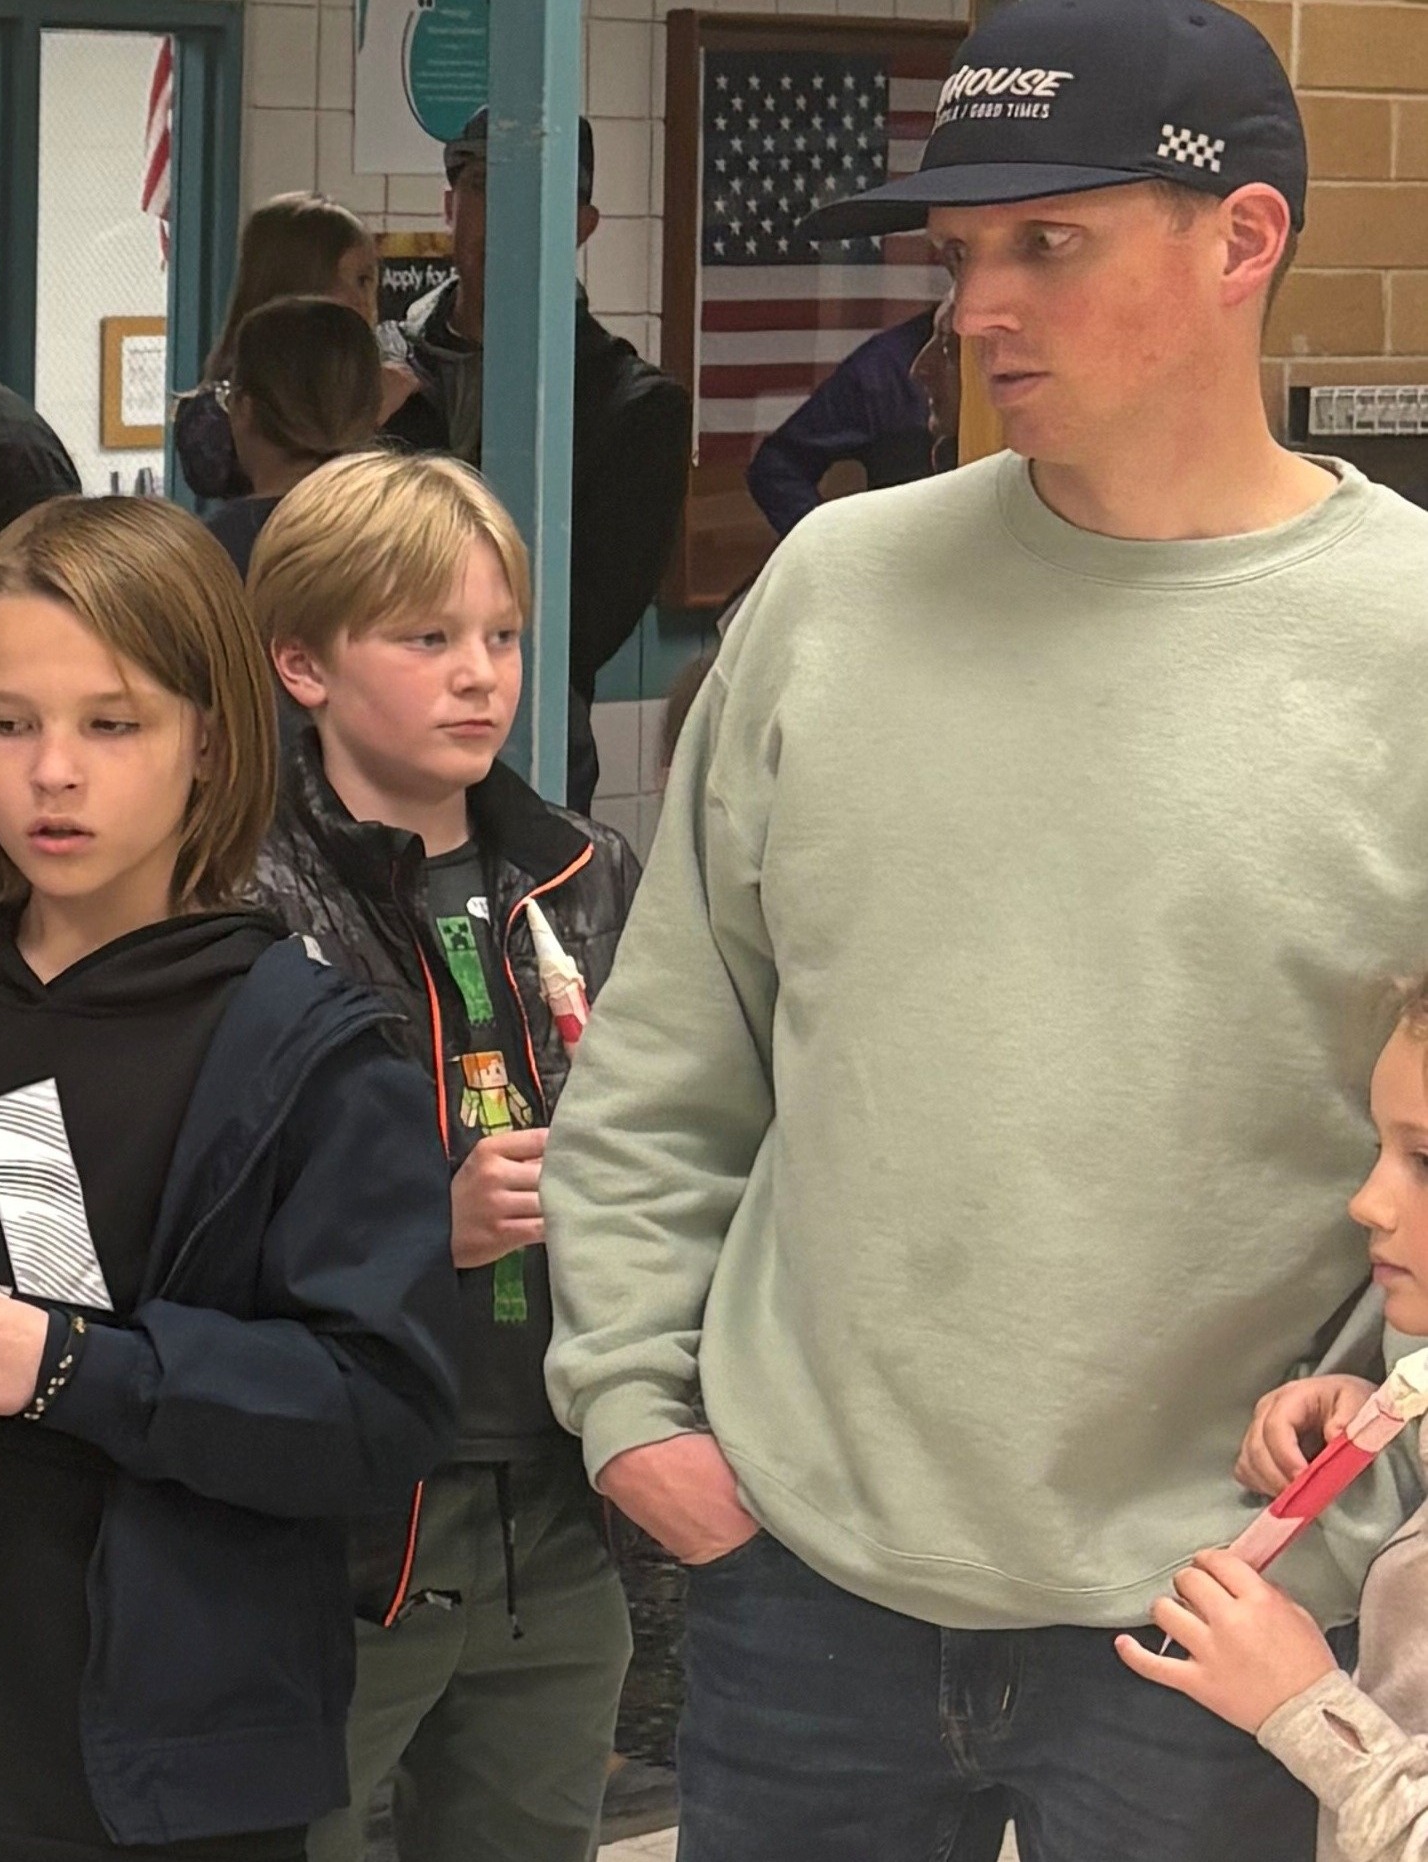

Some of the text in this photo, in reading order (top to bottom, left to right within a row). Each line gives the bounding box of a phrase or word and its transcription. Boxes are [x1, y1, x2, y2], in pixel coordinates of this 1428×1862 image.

[970, 103, 1003, 118] GOOD
[1007, 103, 1050, 118] TIMES
[382, 265, 423, 291] Apply
